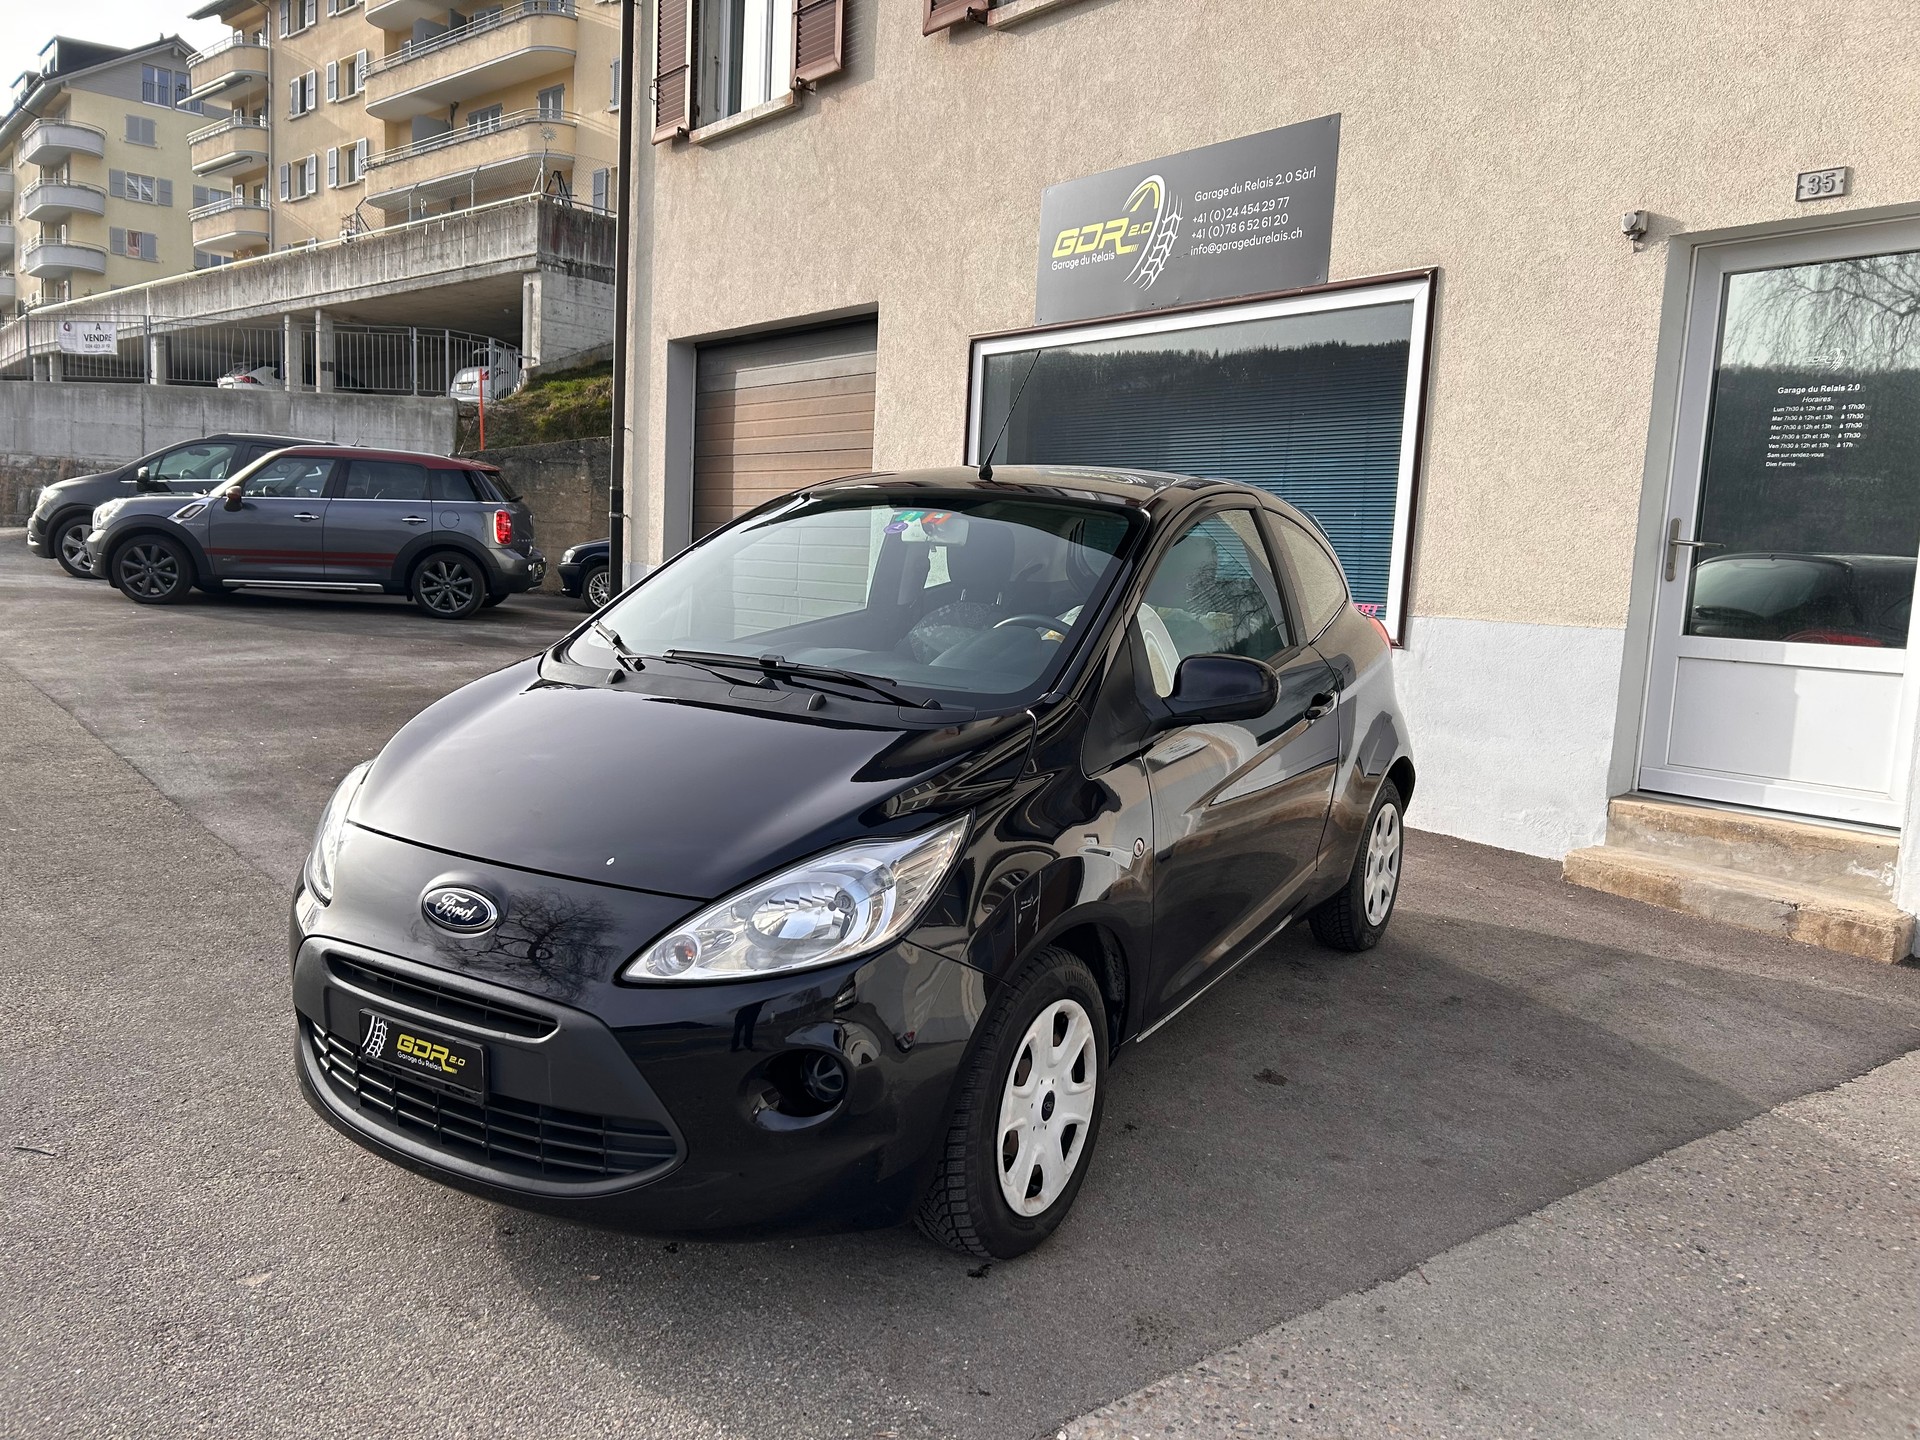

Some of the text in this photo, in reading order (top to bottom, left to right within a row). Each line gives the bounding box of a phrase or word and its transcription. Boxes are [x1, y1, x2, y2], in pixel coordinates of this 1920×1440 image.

[1194, 166, 1317, 202] Garage du Relais 2.0 Sàrl
[1807, 172, 1836, 195] 35
[1192, 196, 1290, 224] +41 (0)24 454 29 77
[1051, 217, 1154, 259] GDR 2.0
[1191, 213, 1289, 240] +41 (0)78 6 52 61 20
[1190, 226, 1303, 256] info@garagedurelais.ch
[1051, 250, 1115, 271] Garage du Relais
[84, 333, 112, 342] VENDRE
[1777, 383, 1860, 395] Garage du Relais 2.0
[1801, 395, 1832, 403] Horaires
[434, 892, 478, 922] Ford
[396, 1033, 466, 1074] GDR 2.0
[396, 1050, 443, 1072] Garage du Relais
